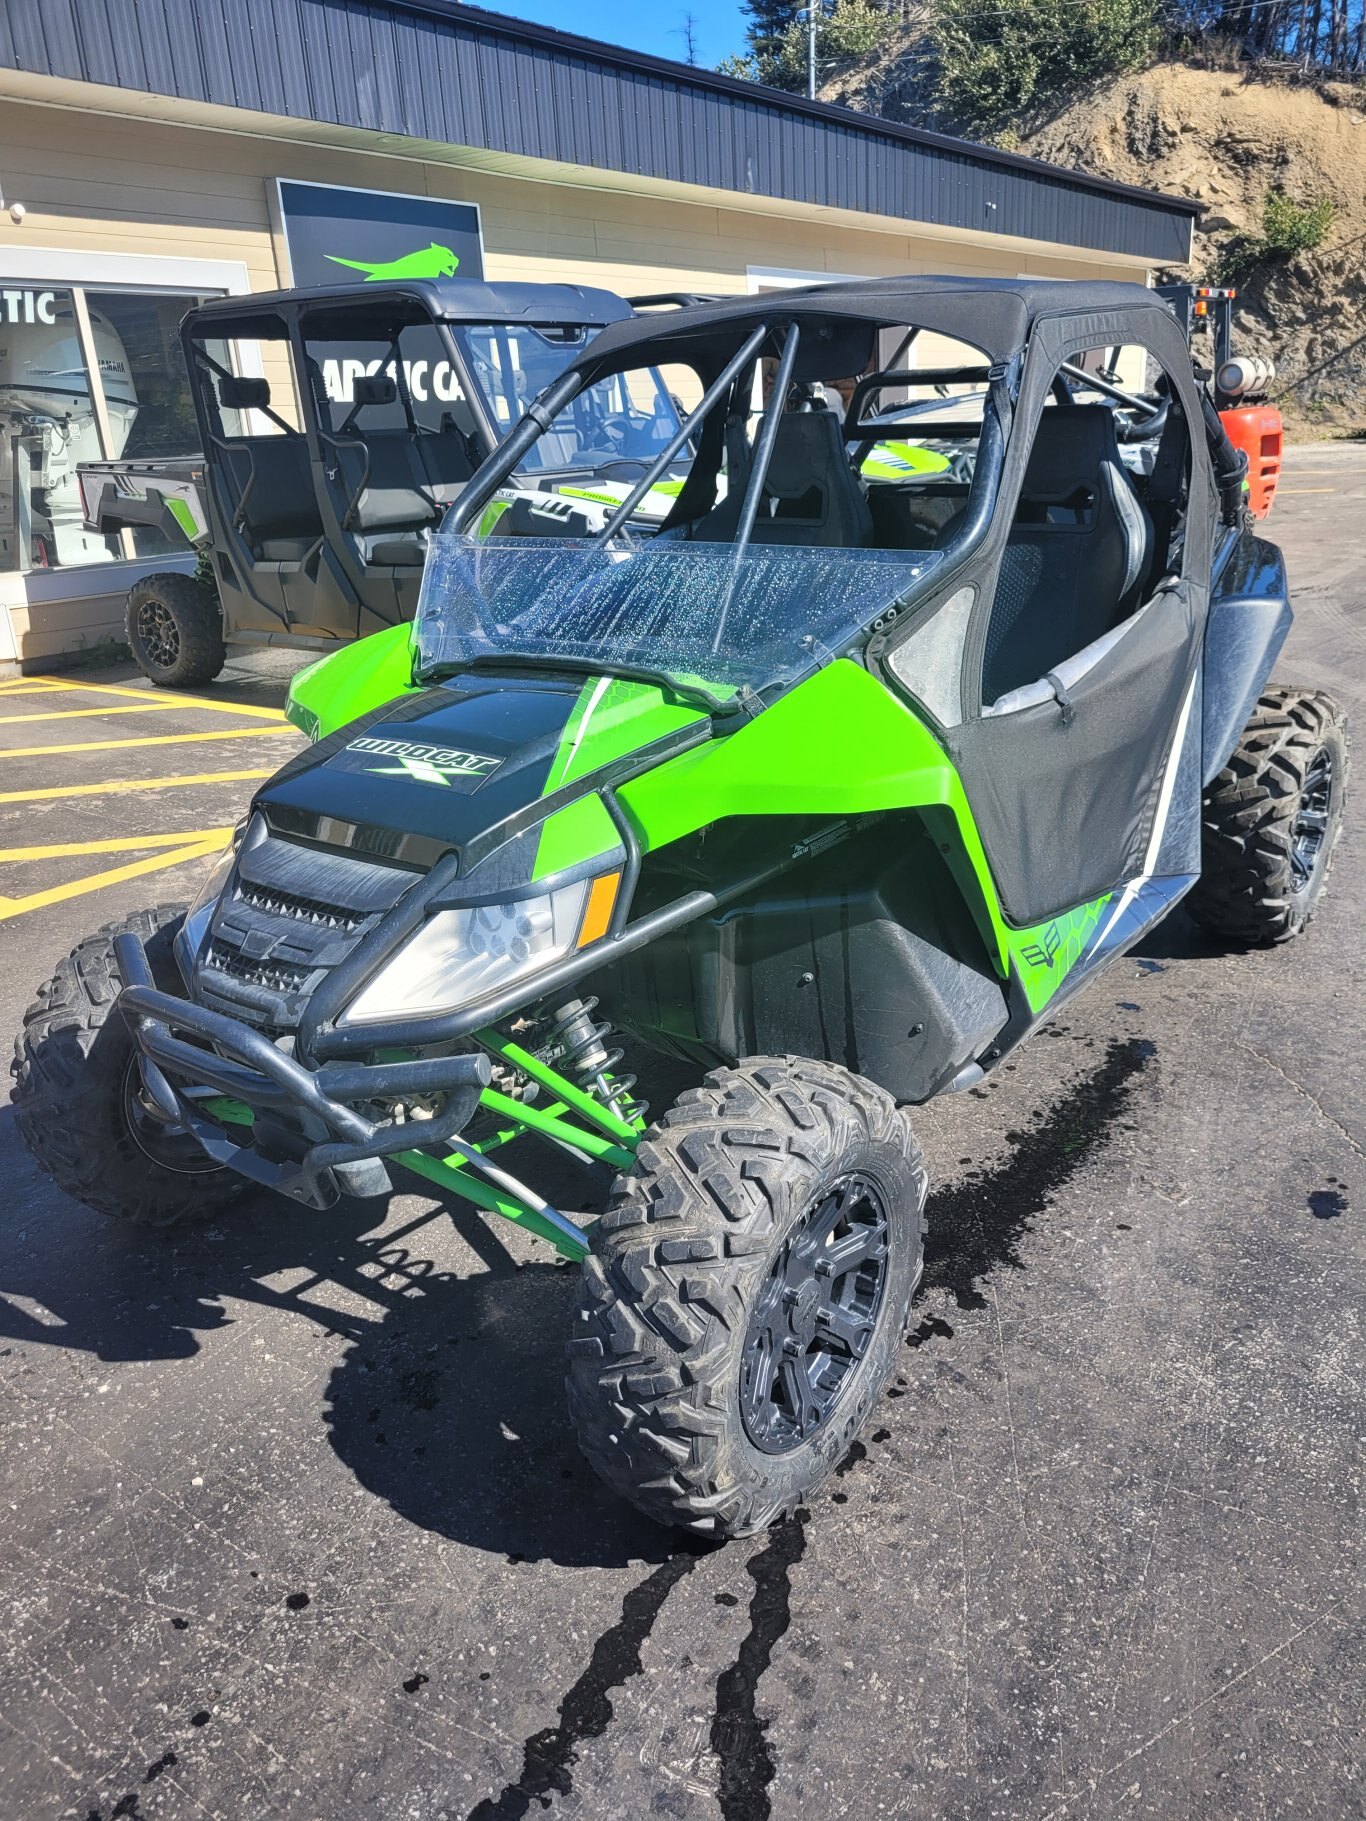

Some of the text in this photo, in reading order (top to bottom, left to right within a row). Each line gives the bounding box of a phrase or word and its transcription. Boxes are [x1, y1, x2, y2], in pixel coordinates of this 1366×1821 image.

[0, 290, 55, 325] TIC
[433, 360, 466, 401] CA
[346, 738, 502, 770] WILDCAT
